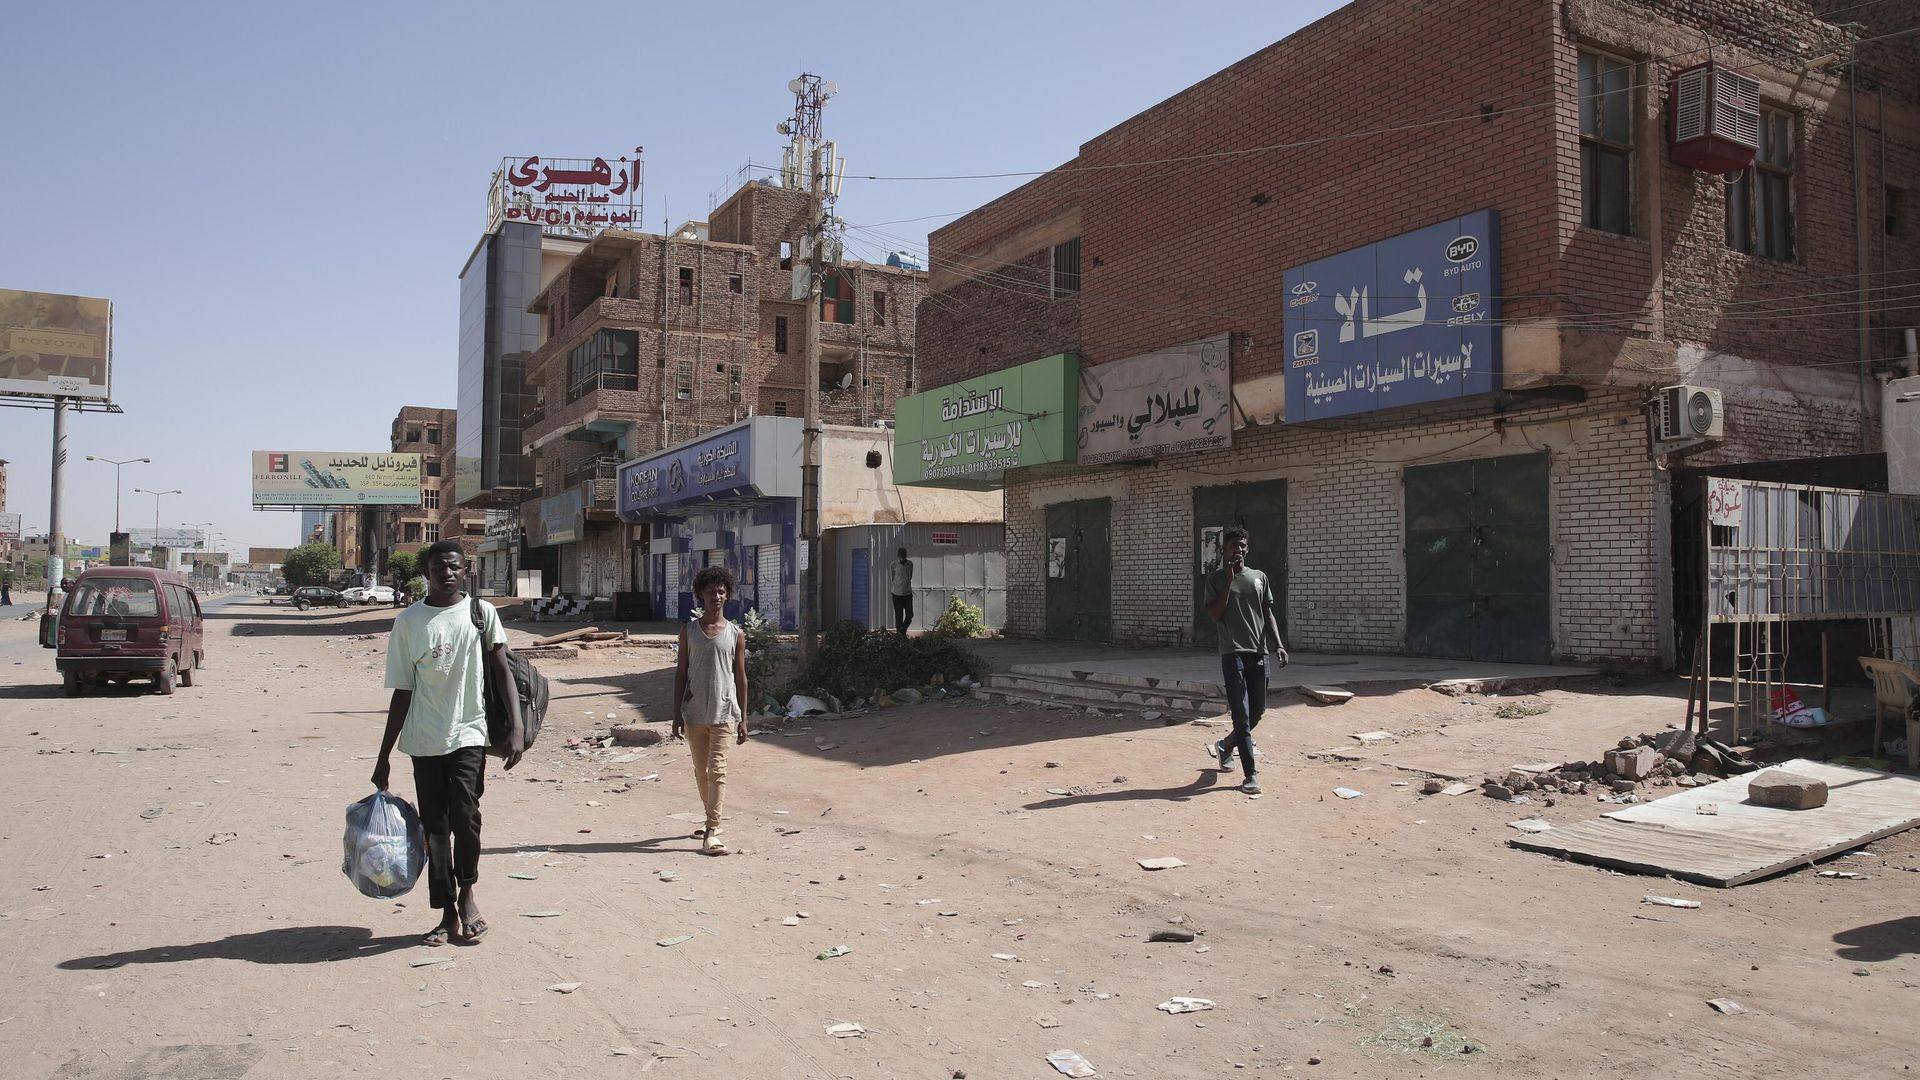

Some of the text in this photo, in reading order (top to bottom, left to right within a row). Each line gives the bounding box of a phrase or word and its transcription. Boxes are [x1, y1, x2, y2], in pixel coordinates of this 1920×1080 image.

[545, 188, 609, 205] عبد الحليم
[507, 207, 561, 224] PVC
[1449, 241, 1475, 258] BYD
[1443, 260, 1482, 277] BYD AUTO
[1289, 292, 1320, 307] CHERY
[18, 336, 89, 349] TOYOTA
[1354, 355, 1411, 393] السيارات
[1304, 367, 1352, 405] الصينية
[1089, 413, 1125, 433] والسيور
[922, 431, 962, 468] الكورية
[329, 456, 369, 471] للحديد
[630, 467, 658, 487] KOREAN
